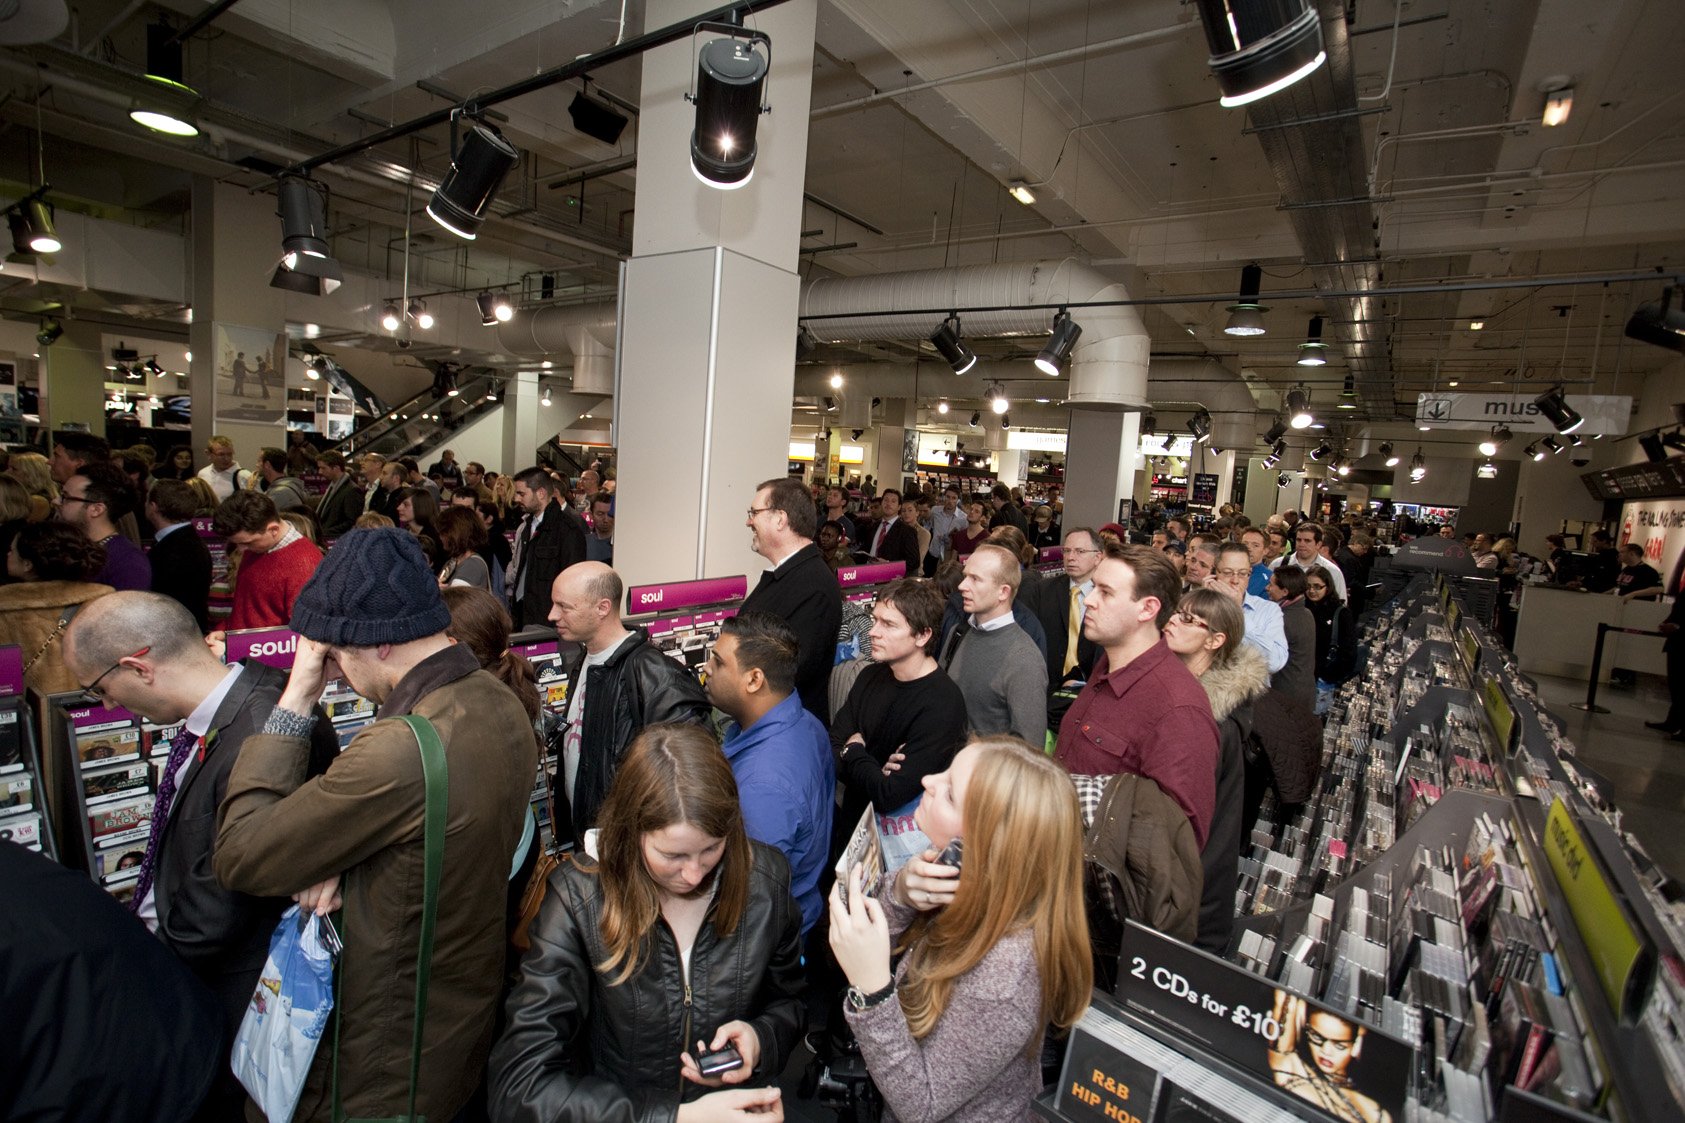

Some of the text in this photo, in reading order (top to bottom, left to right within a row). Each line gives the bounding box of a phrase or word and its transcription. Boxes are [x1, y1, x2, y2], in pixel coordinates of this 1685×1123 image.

[1484, 401, 1544, 416] mus
[1409, 549, 1444, 557] recommend
[843, 569, 857, 581] soul
[640, 588, 663, 604] soul
[249, 635, 297, 657] soul
[70, 709, 90, 719] soul
[104, 811, 151, 829] BROWN
[1550, 816, 1569, 858] music
[1130, 956, 1147, 980] 2
[1152, 966, 1198, 1004] CDs
[1201, 993, 1228, 1017] for
[1231, 1004, 1280, 1041] £10
[1091, 1068, 1130, 1100] R&B
[1071, 1081, 1102, 1107] HIP
